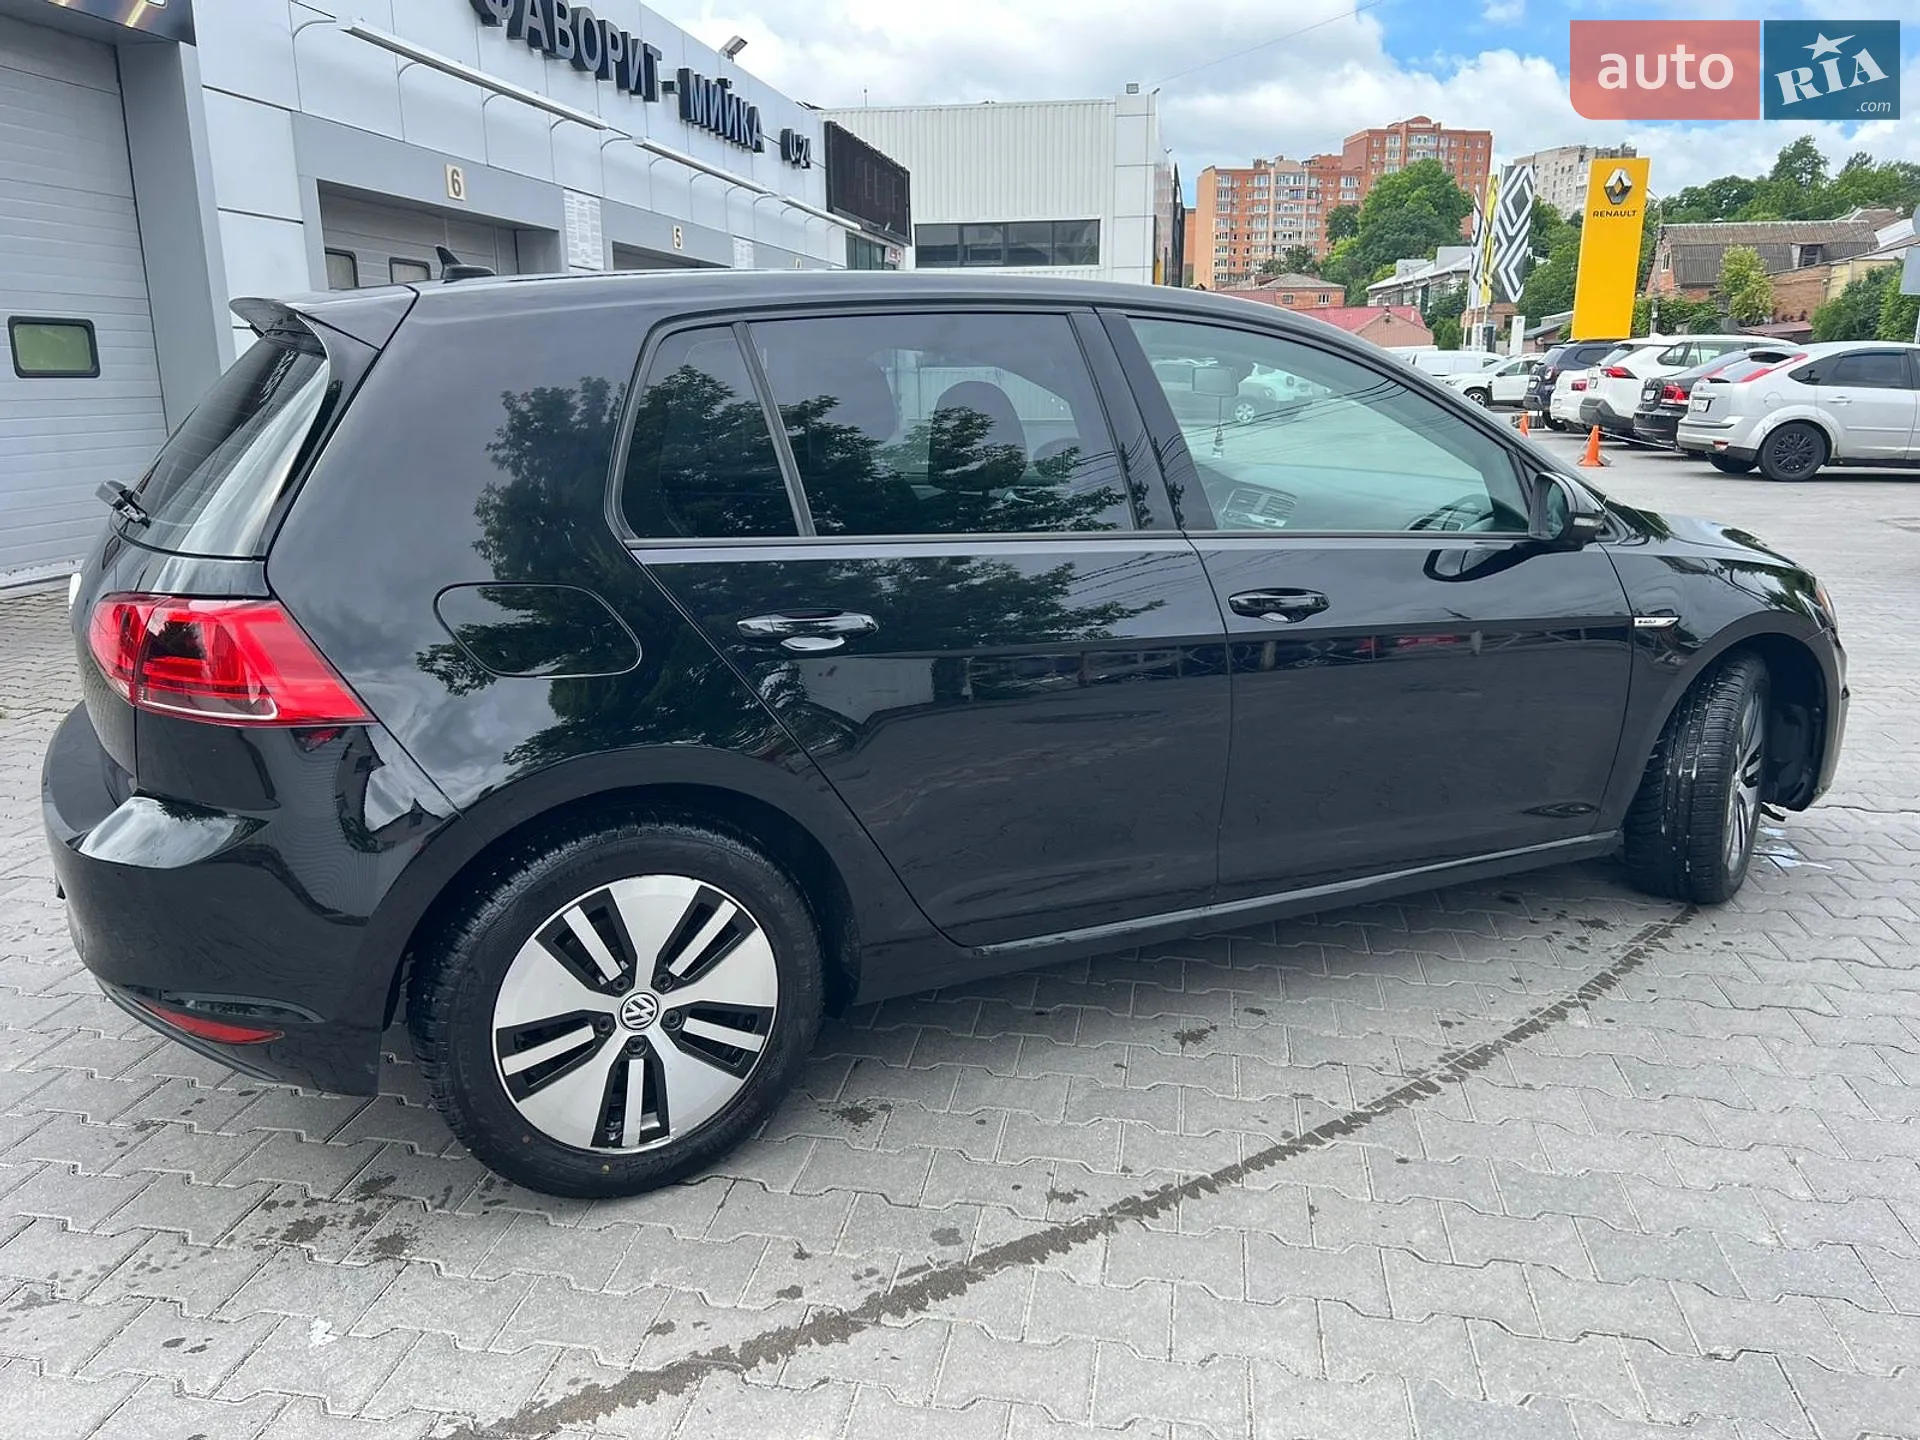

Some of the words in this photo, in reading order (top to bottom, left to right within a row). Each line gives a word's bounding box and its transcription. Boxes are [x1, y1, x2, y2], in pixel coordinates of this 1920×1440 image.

[677, 67, 765, 153] МИЙКА
[451, 167, 462, 197] 6
[1592, 209, 1638, 218] RENAULT
[674, 227, 682, 248] 5
